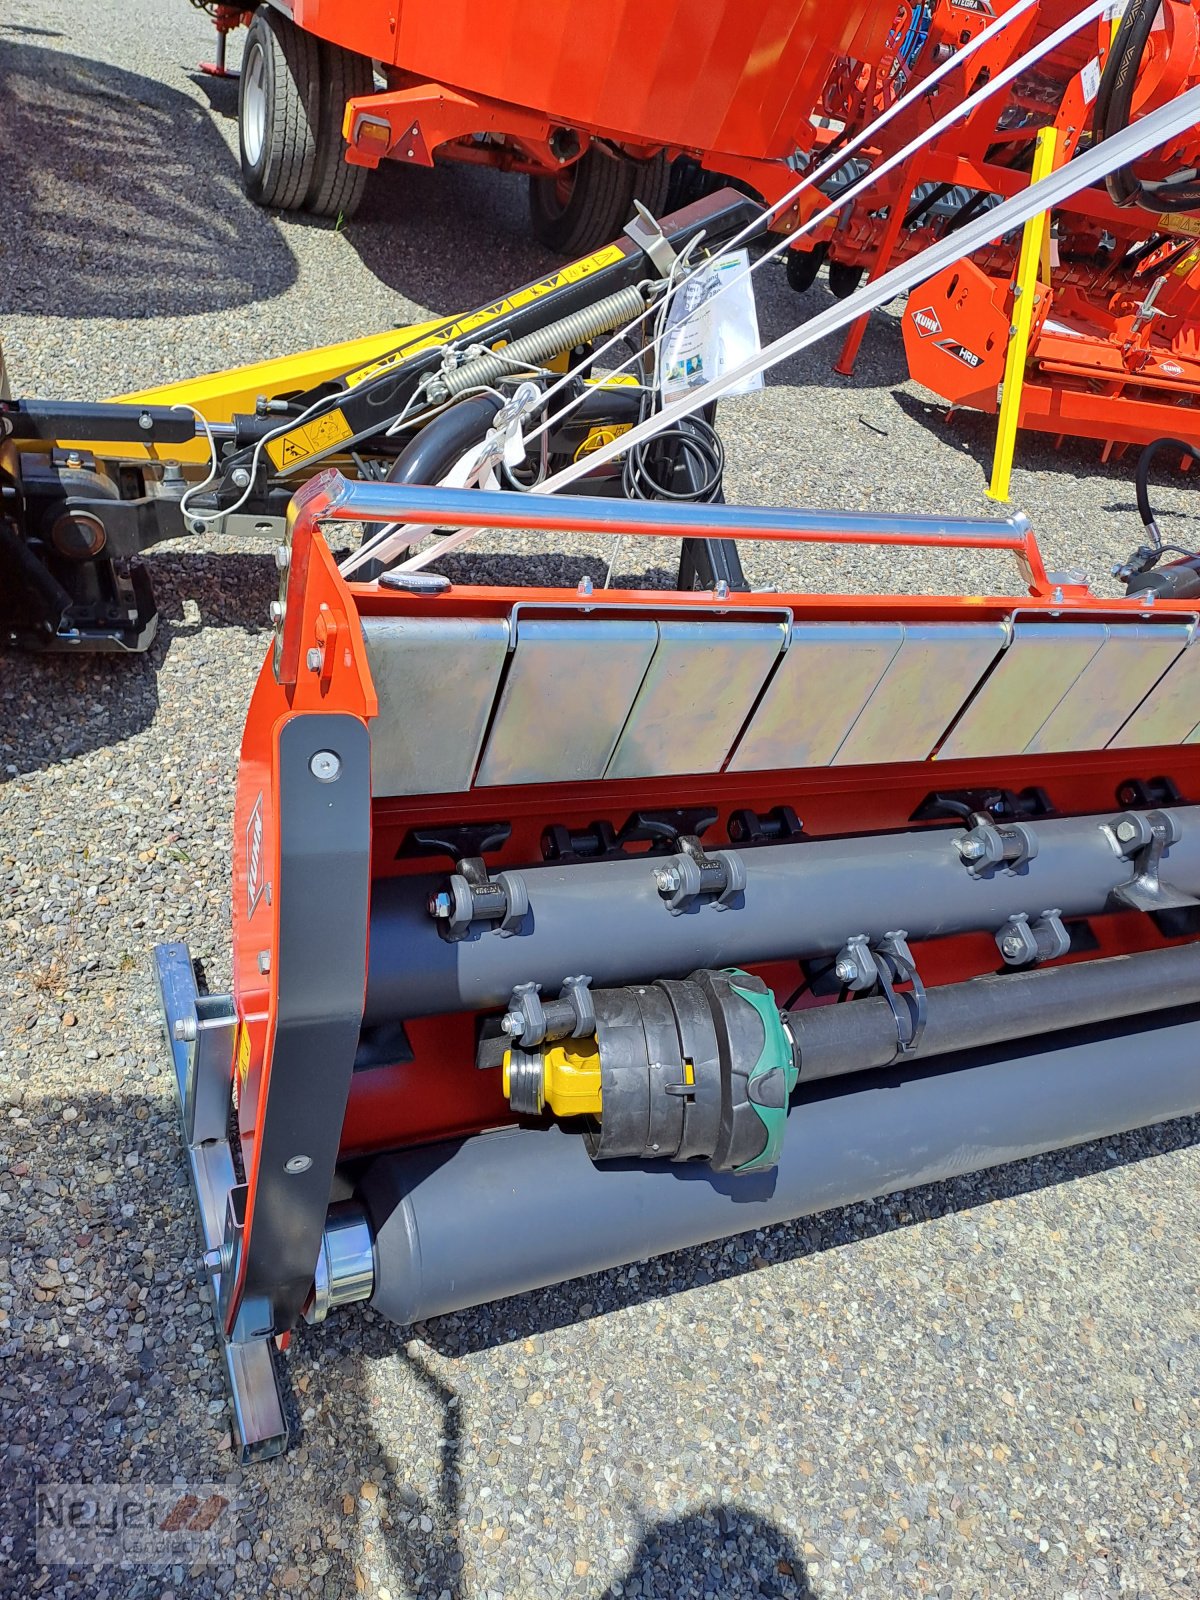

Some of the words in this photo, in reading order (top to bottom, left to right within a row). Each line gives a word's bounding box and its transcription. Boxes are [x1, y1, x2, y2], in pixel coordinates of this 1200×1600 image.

[915, 313, 938, 332] KUHN
[959, 347, 979, 366] HRB
[1163, 365, 1181, 373] KUHN
[249, 809, 262, 904] KUHN
